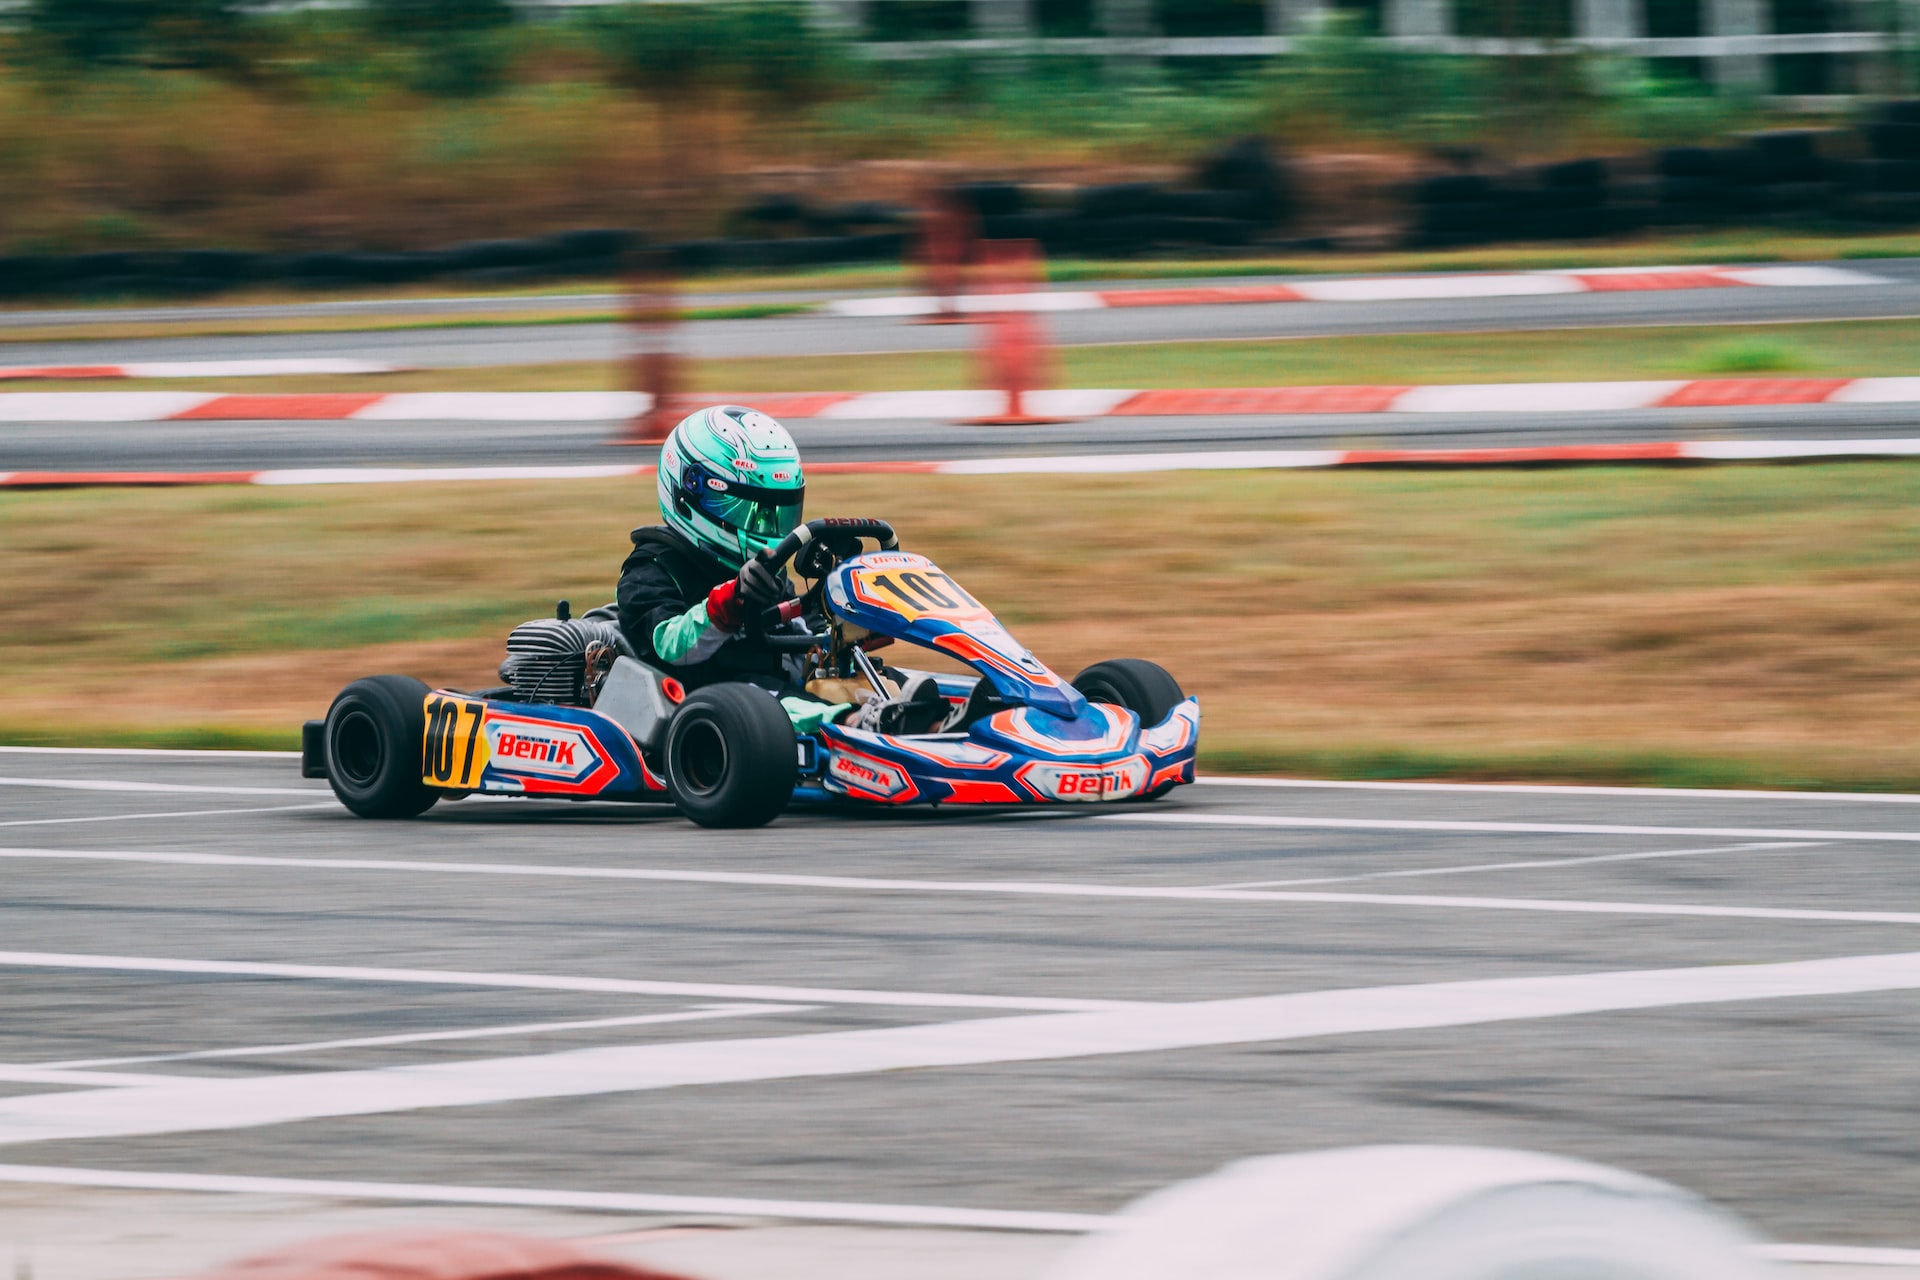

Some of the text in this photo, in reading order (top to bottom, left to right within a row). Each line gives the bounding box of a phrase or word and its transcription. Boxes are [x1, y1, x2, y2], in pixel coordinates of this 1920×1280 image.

[735, 459, 755, 470] BELL
[773, 472, 790, 480] BELL
[709, 479, 725, 489] BELL
[872, 571, 982, 612] 107
[423, 697, 484, 785] 107
